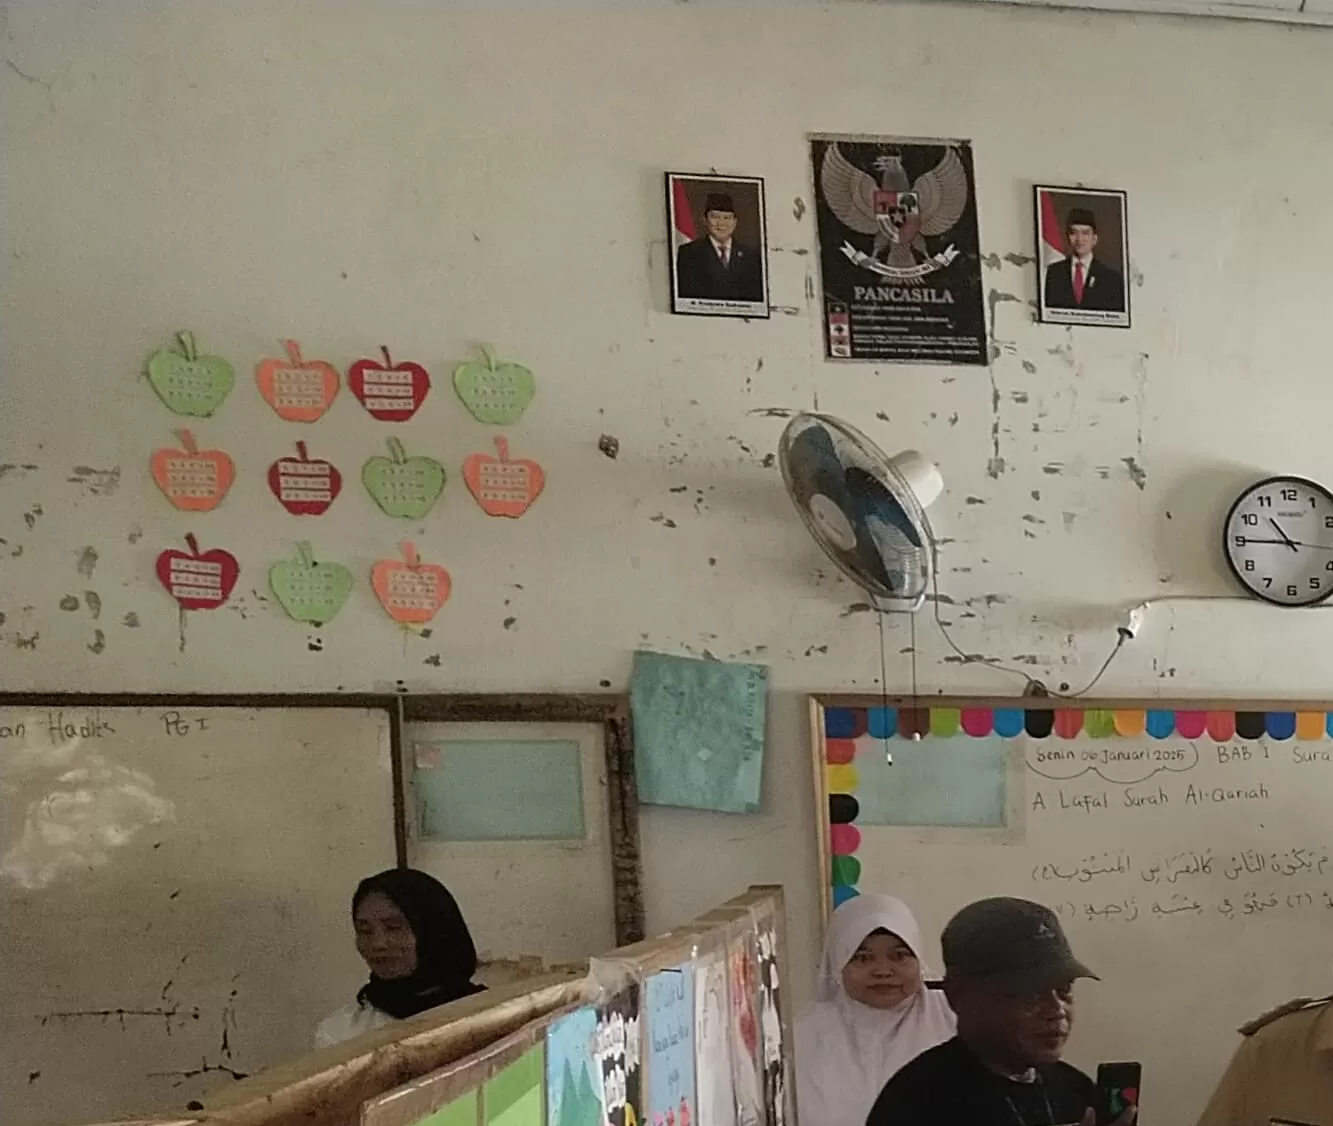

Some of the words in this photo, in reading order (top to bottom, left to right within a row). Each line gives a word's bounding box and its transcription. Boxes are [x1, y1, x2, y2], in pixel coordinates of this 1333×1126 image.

[853, 286, 955, 303] PANCASILA
[1280, 489, 1298, 501] 12
[1257, 495, 1271, 508] 11
[1308, 497, 1316, 508] 1
[1240, 513, 1258, 526] 10
[1235, 535, 1247, 547] 9
[1244, 559, 1255, 571] 8
[1262, 577, 1273, 588] 7
[1309, 577, 1320, 589] 5
[1287, 585, 1297, 596] 6
[1036, 747, 1075, 763] Senin
[1100, 749, 1150, 764] Januari
[1155, 749, 1185, 761] 2025
[1217, 745, 1253, 764] BAB
[1032, 791, 1047, 811] A
[1060, 789, 1108, 814] Lafal
[1123, 785, 1169, 808] Surah
[1185, 783, 1269, 806] Al-Qariah
